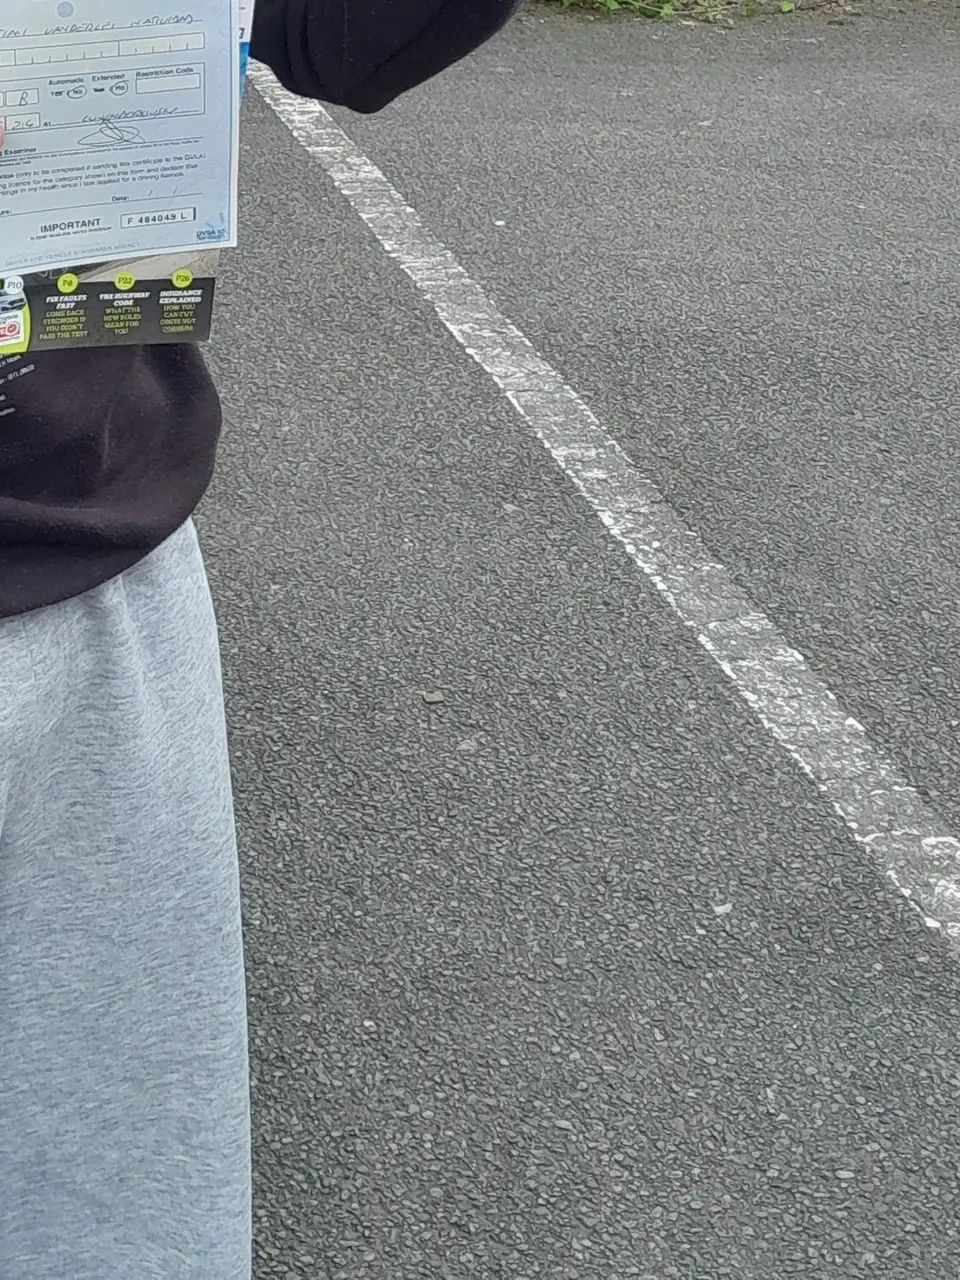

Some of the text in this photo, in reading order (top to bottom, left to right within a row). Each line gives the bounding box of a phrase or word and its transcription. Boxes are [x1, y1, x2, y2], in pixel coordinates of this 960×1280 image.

[138, 214, 176, 223] 484049
[41, 218, 101, 233] IMPORTANT
[7, 281, 22, 289] P10
